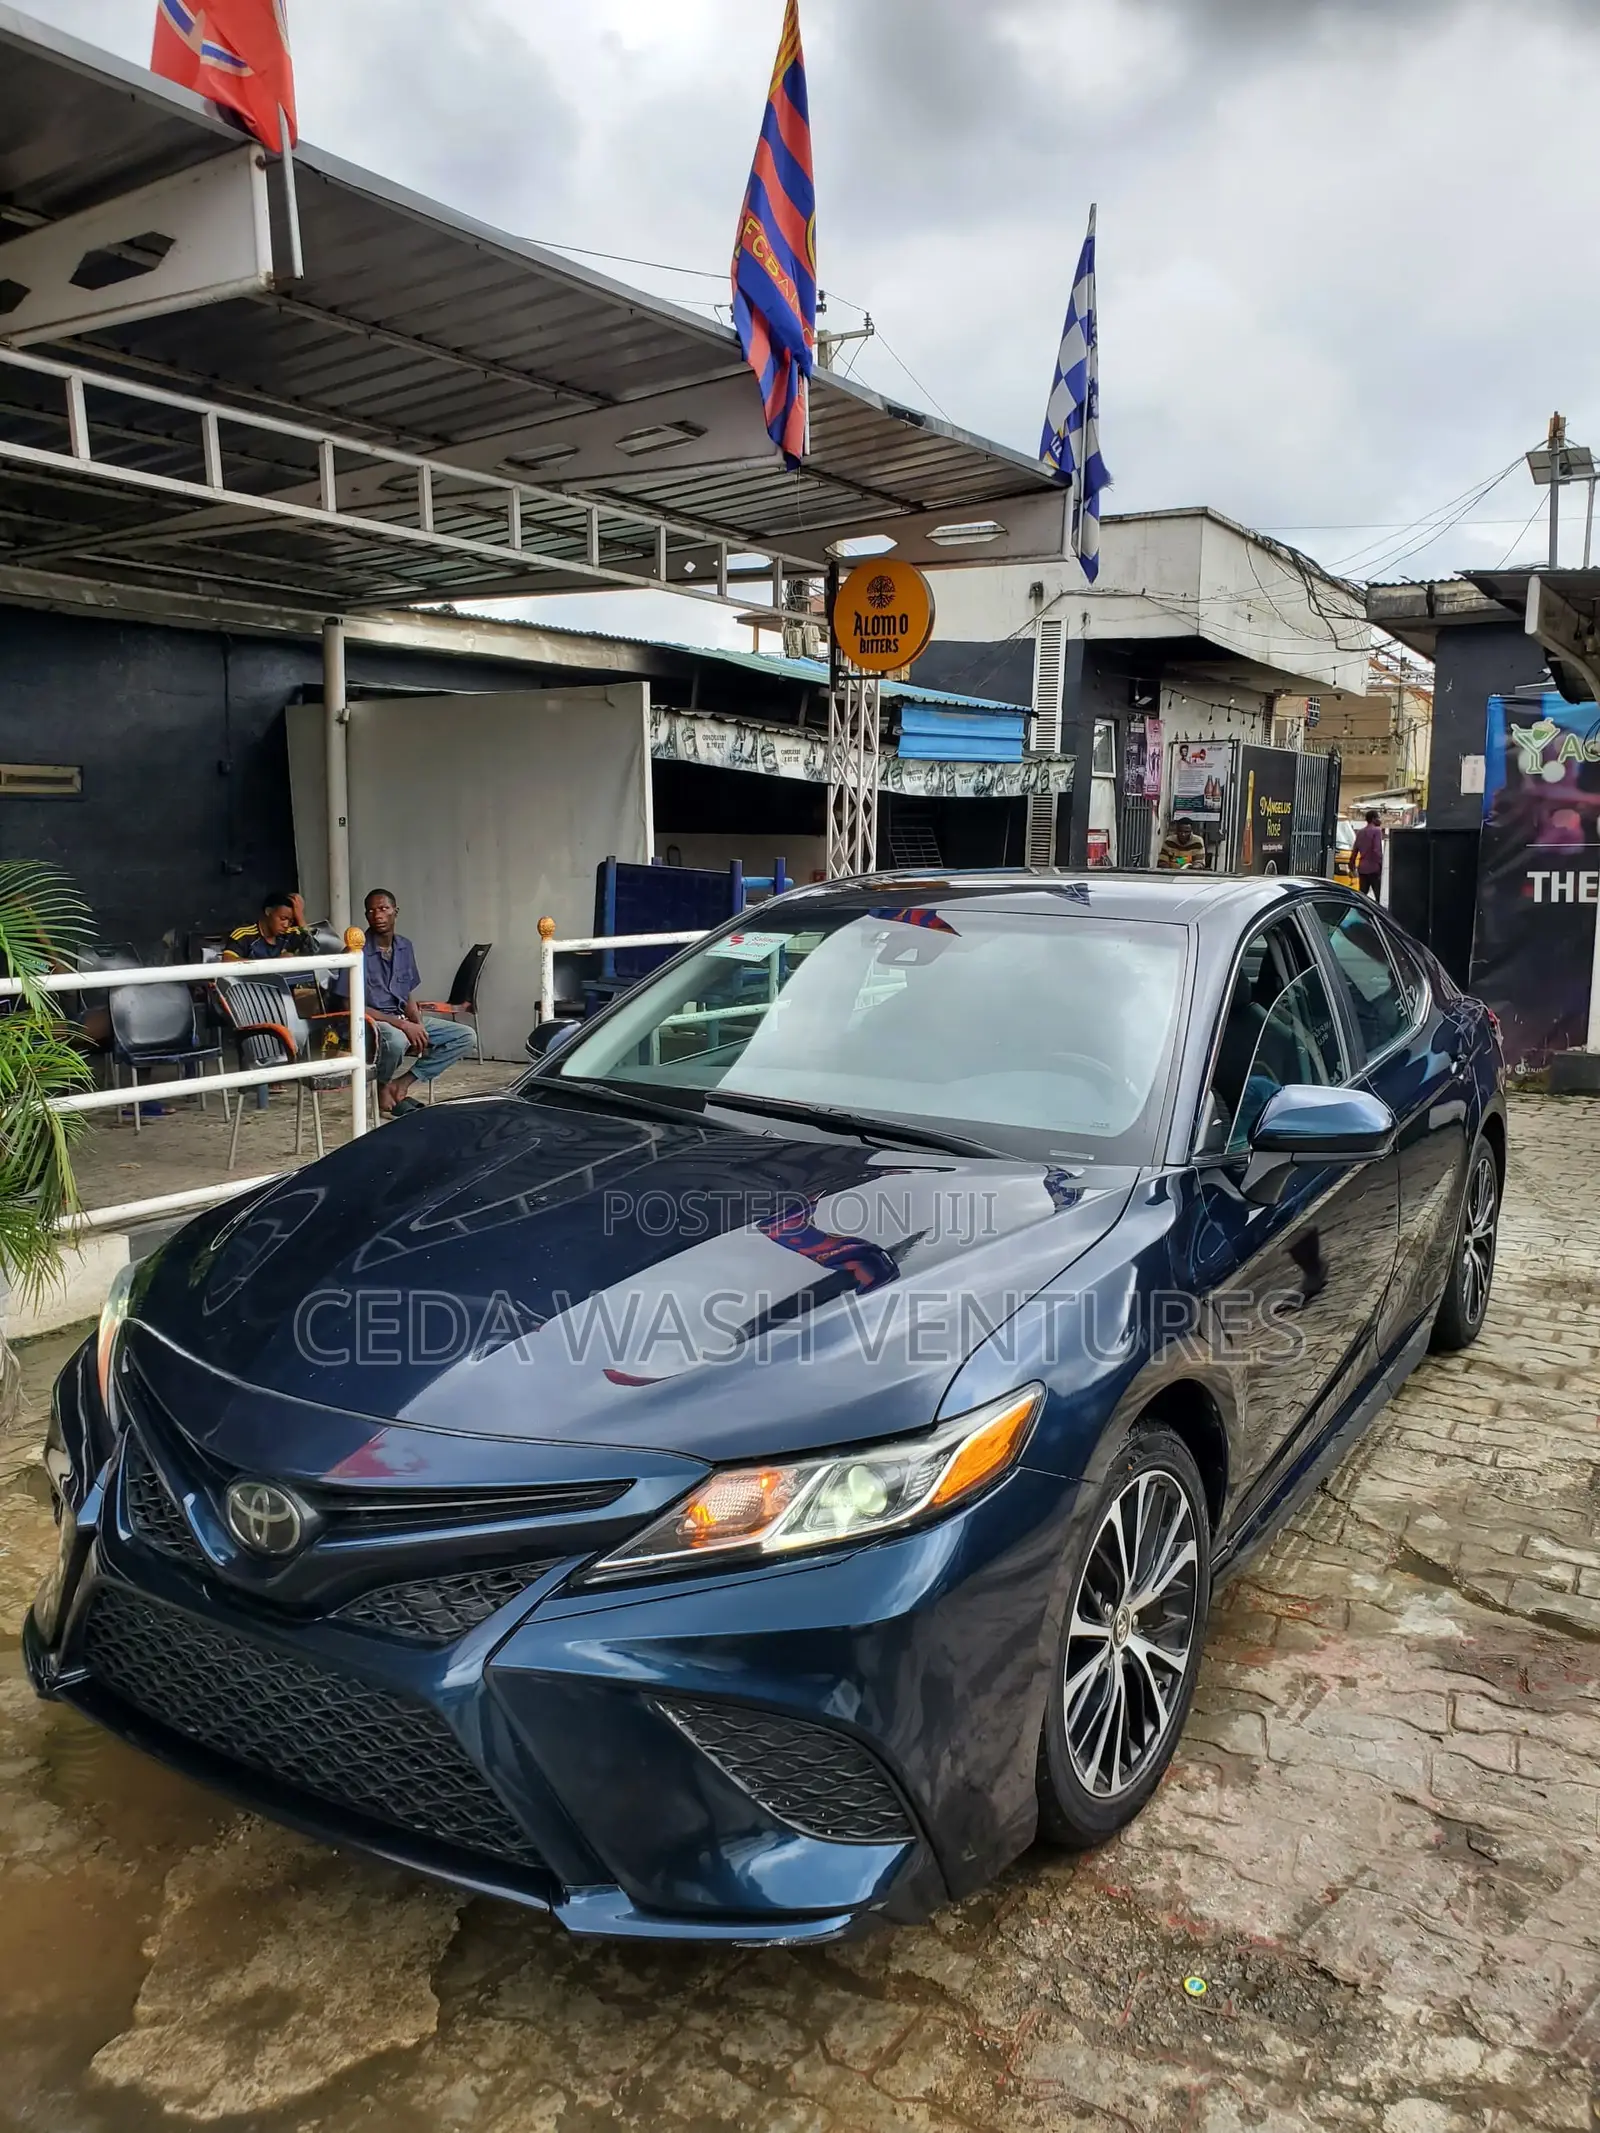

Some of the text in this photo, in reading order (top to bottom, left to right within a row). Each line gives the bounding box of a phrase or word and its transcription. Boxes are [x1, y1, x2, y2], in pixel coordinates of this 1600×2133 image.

[853, 610, 909, 637] ALOMO
[859, 637, 899, 654] BITTERS
[1527, 870, 1599, 904] THE
